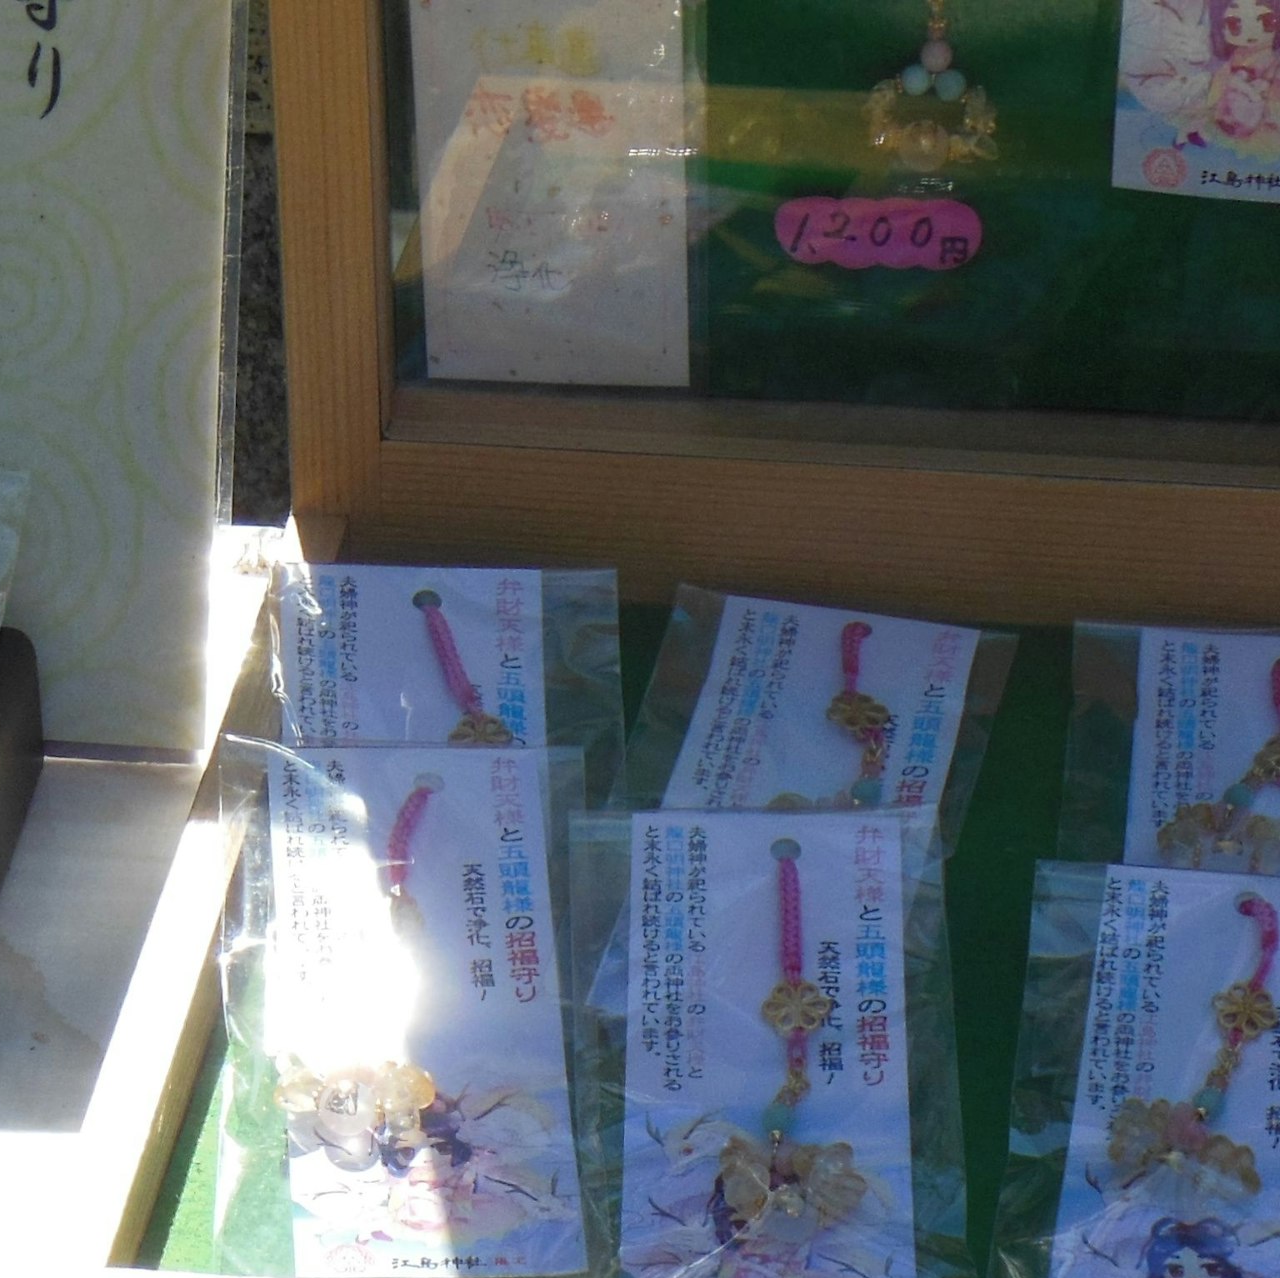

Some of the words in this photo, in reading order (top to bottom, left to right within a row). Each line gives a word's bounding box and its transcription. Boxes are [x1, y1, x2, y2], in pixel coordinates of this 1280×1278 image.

[495, 577, 527, 746] 弁財天様と五頭龍様
[854, 825, 890, 1087] 弁財天様と五頭龍様の招福守り
